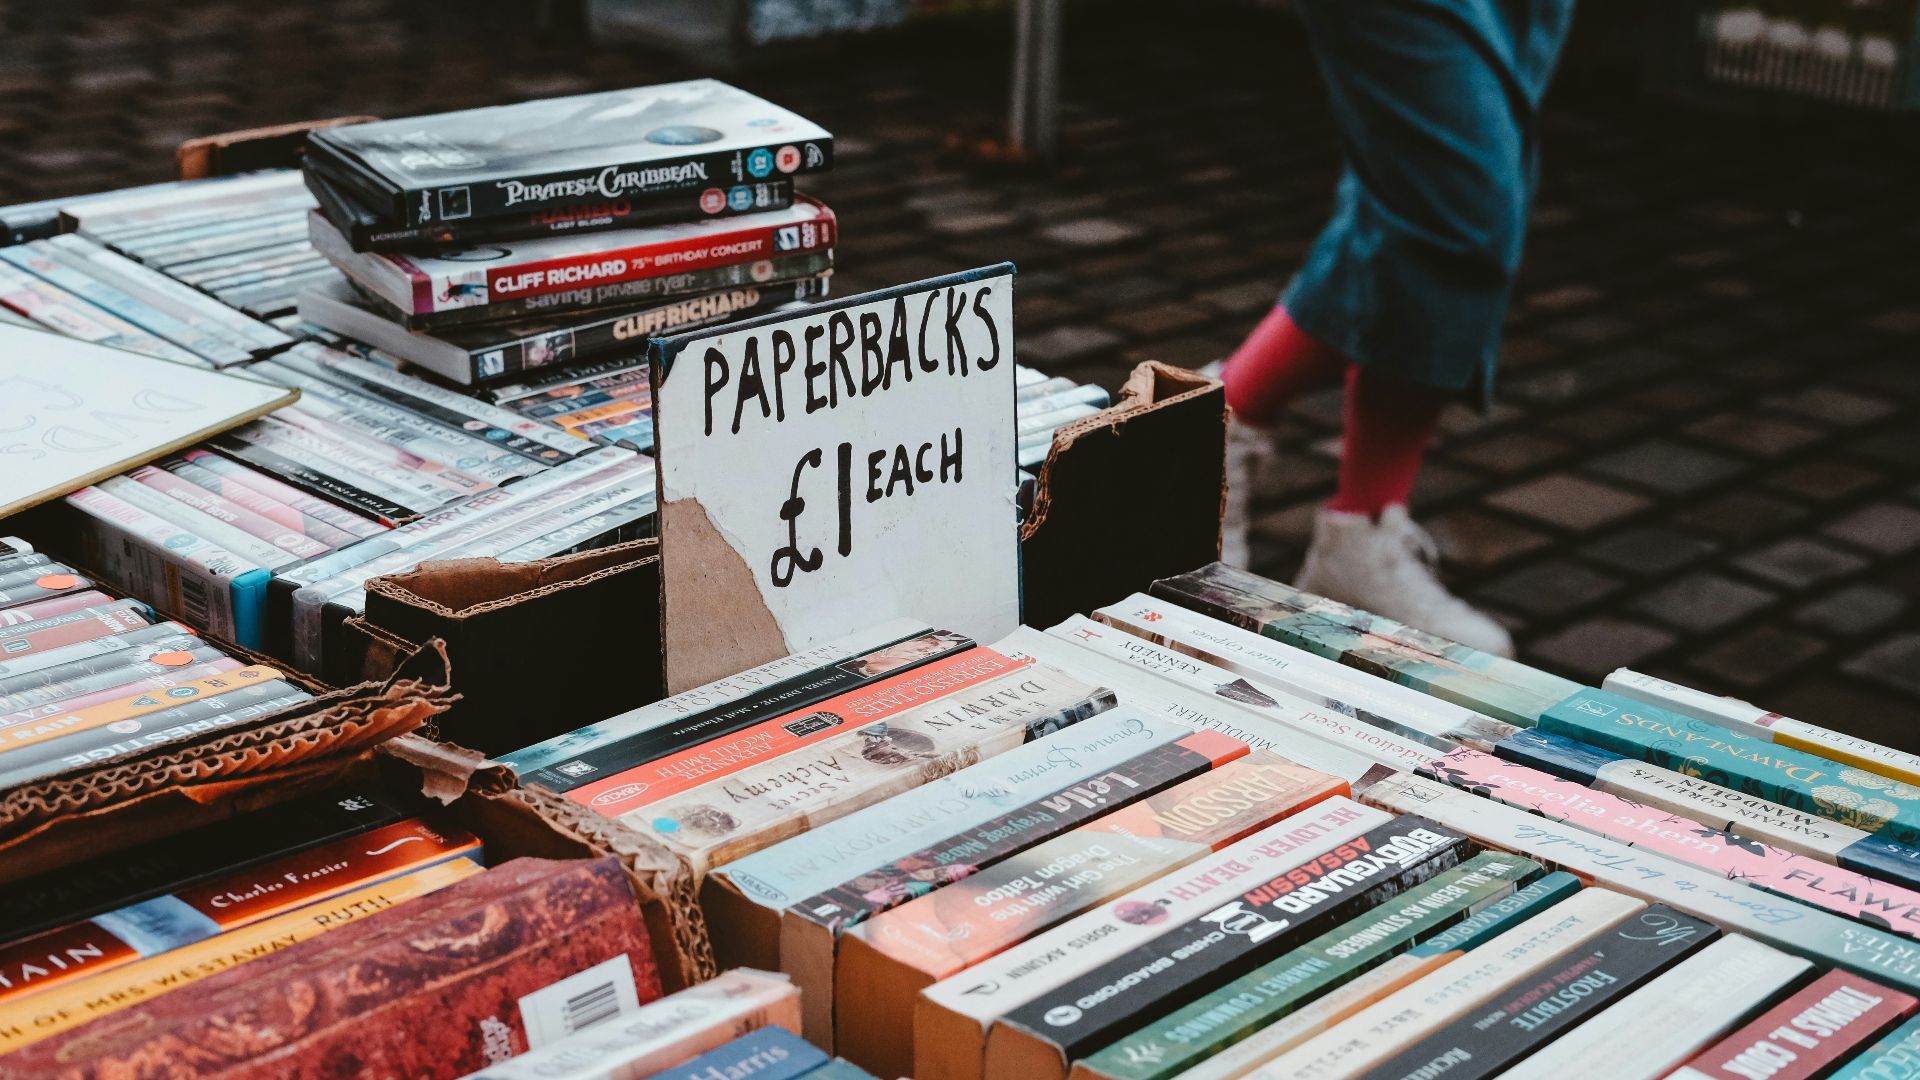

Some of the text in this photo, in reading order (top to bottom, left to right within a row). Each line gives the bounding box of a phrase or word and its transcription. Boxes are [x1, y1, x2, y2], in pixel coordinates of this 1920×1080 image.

[494, 270, 545, 294] CLIFF
[547, 259, 627, 286] RICHARD
[654, 249, 708, 267] BIRTHDAY
[710, 239, 762, 258] CONCERT
[704, 286, 1000, 437] PAPERBACKS
[402, 508, 460, 536] HAPPY
[465, 490, 514, 511] FEET
[770, 427, 962, 588] £1 EACH
[1118, 641, 1202, 675] KENNEDY
[1129, 655, 1173, 673] LENA
[1191, 629, 1289, 670] Water Gypsies
[671, 673, 784, 713] TAYLOR
[855, 658, 1006, 718] ESPRESSO TALES
[923, 680, 1047, 731] DARWIN
[61, 697, 297, 766] THE PRESTIGE
[970, 701, 1048, 731] EMMA
[1167, 702, 1279, 750] MIDDLEMERE
[1299, 711, 1437, 764] ndelion Seed
[656, 754, 708, 779] SMITH
[678, 743, 774, 781] ALEXANDER
[1008, 718, 1154, 785] Emma Brown
[1615, 712, 1827, 785] DAWNLANDS
[1804, 728, 1897, 759] HASLETT
[595, 784, 644, 805] ABACUS
[721, 754, 847, 804] Alchemy
[774, 779, 841, 811] Secret
[1040, 771, 1141, 813] Leila
[1152, 764, 1306, 838] LARSSON
[1681, 778, 1822, 826] MANDOLIN
[934, 811, 1054, 864] Prayaag Akbar
[1319, 806, 1364, 833] HE
[1488, 774, 1721, 858] cecelia ahern
[1736, 808, 1830, 840] CAPTAIN
[776, 829, 891, 883] BOYLAN
[1252, 820, 1324, 861] LOVER
[210, 860, 349, 908] Charles Frazier
[973, 843, 1112, 908] Dragon Tattoo
[990, 854, 1140, 922] The Girl with the
[1168, 858, 1252, 902] DEATH
[1246, 836, 1372, 908] ASSASSIN
[1272, 826, 1456, 914] BODYGUARD
[1428, 878, 1470, 909] BEGIN
[1468, 866, 1493, 888] ALL
[1514, 824, 1804, 926] Born to be Trouble
[1399, 903, 1431, 921] AS
[1497, 881, 1551, 913] JAVIER
[1005, 924, 1119, 980] BORIS AKUNIN
[1325, 914, 1413, 958] STRANGERS
[1502, 914, 1585, 962] American
[1840, 929, 1920, 960] RIES
[1843, 942, 1920, 978] EILA
[33, 1010, 71, 1028] OF
[84, 986, 147, 1011] MRS
[152, 934, 297, 986] WESTAWAY
[312, 895, 393, 928] RUTH
[1075, 931, 1227, 1010] CHRIS BRADFORD
[1262, 957, 1332, 996] HARRIET
[1163, 986, 1261, 1045] CUMMINGS
[1509, 969, 1619, 1033] FROSTBITE
[1791, 985, 1884, 1037] THOMAS
[1722, 1040, 1798, 1080] COOK
